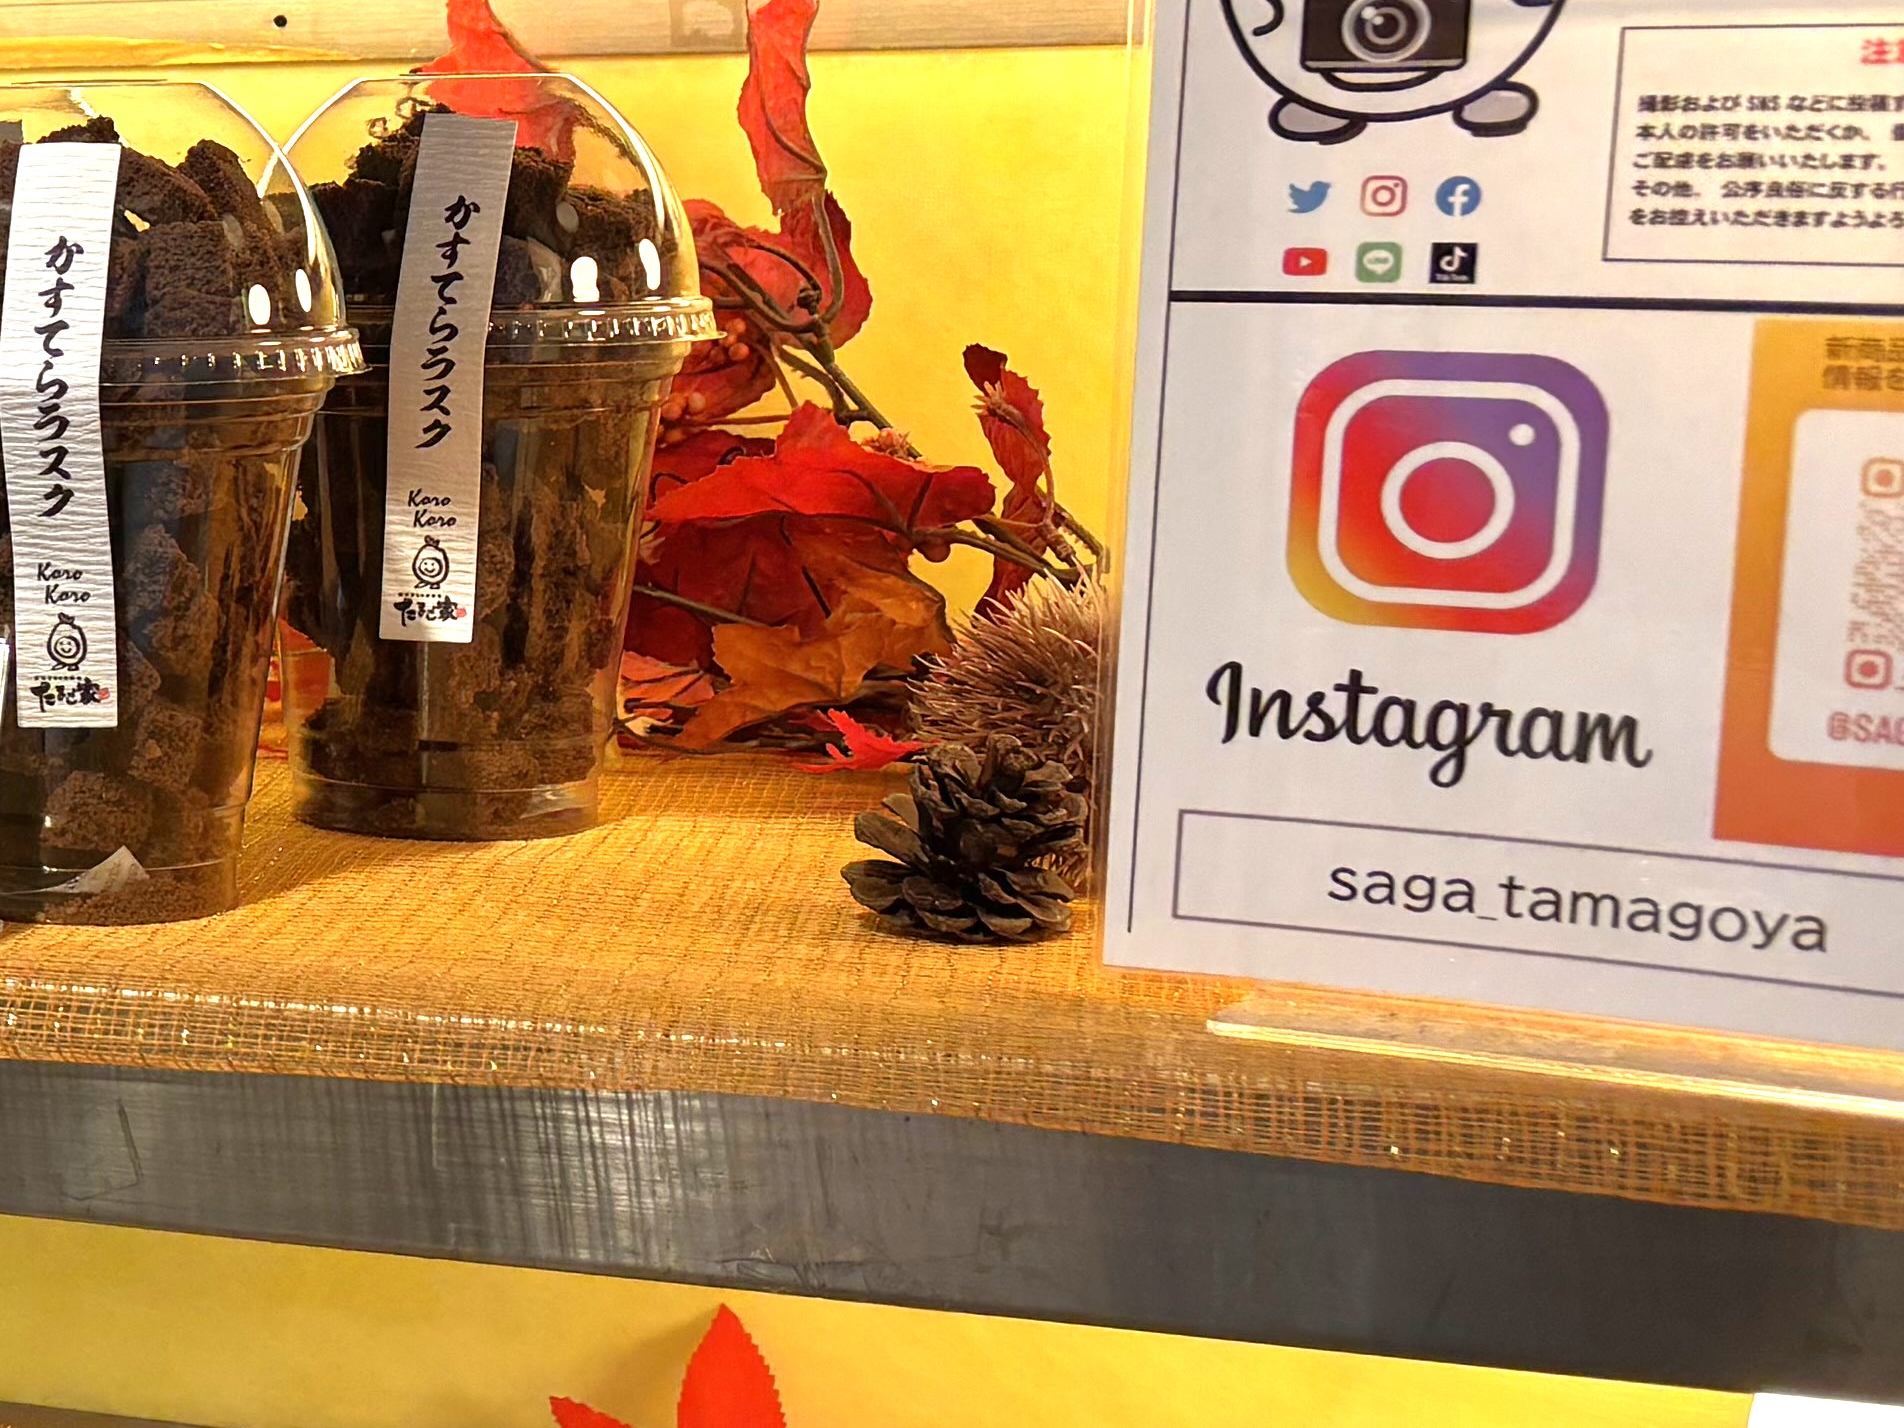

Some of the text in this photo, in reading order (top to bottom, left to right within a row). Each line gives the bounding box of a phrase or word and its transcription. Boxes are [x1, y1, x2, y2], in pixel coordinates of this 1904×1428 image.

[415, 195, 482, 450] かすてらラスク
[31, 236, 86, 520] かすてらラスク
[407, 488, 451, 507] Koro
[413, 509, 457, 528] Koro
[37, 561, 83, 582] Koro
[44, 584, 92, 604] Koro
[1206, 660, 1652, 788] Instagram
[1327, 863, 1828, 953] saga_tamagoya
